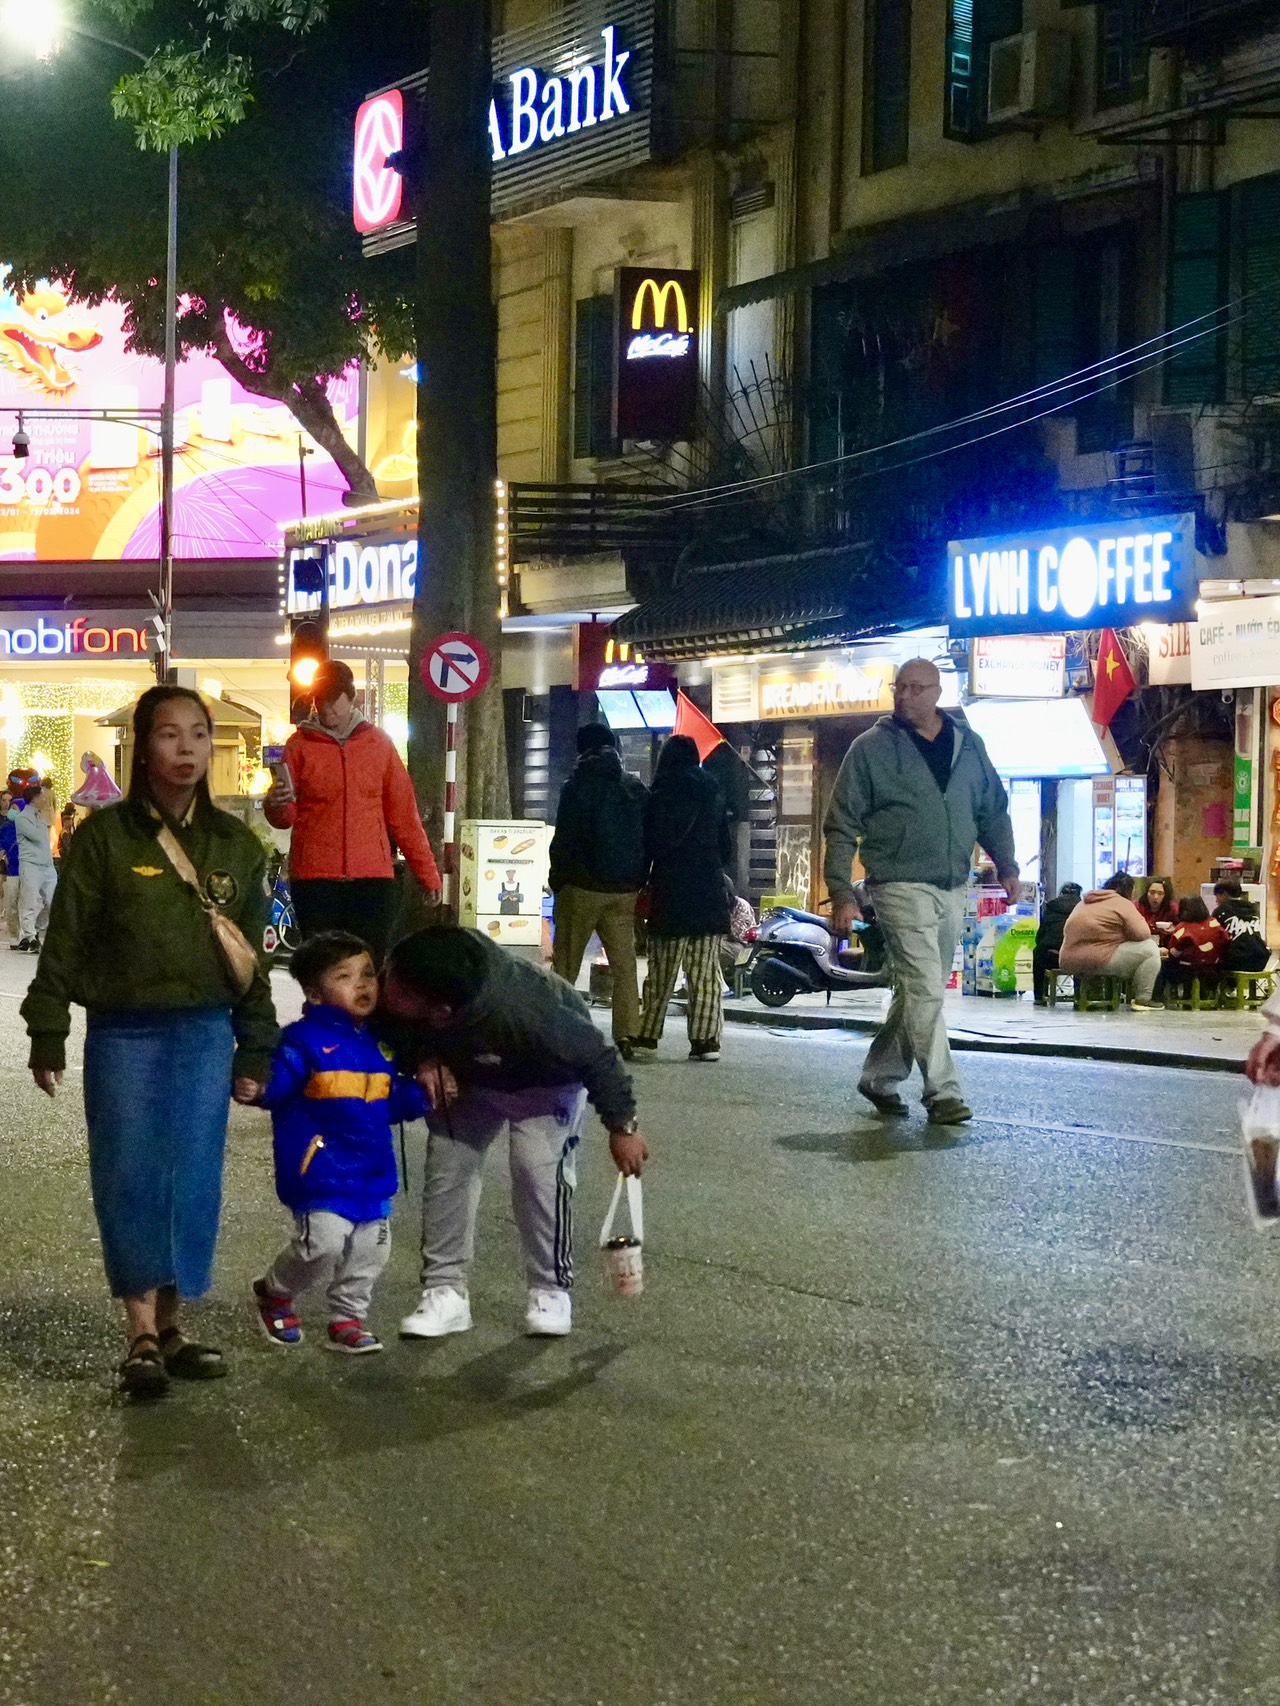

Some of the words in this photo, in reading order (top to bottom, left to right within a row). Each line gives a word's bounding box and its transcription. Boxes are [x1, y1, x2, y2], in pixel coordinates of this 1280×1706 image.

[954, 549, 1029, 618] LYNH
[1038, 532, 1172, 618] COFFEE
[1200, 622, 1224, 646] CAFÉ
